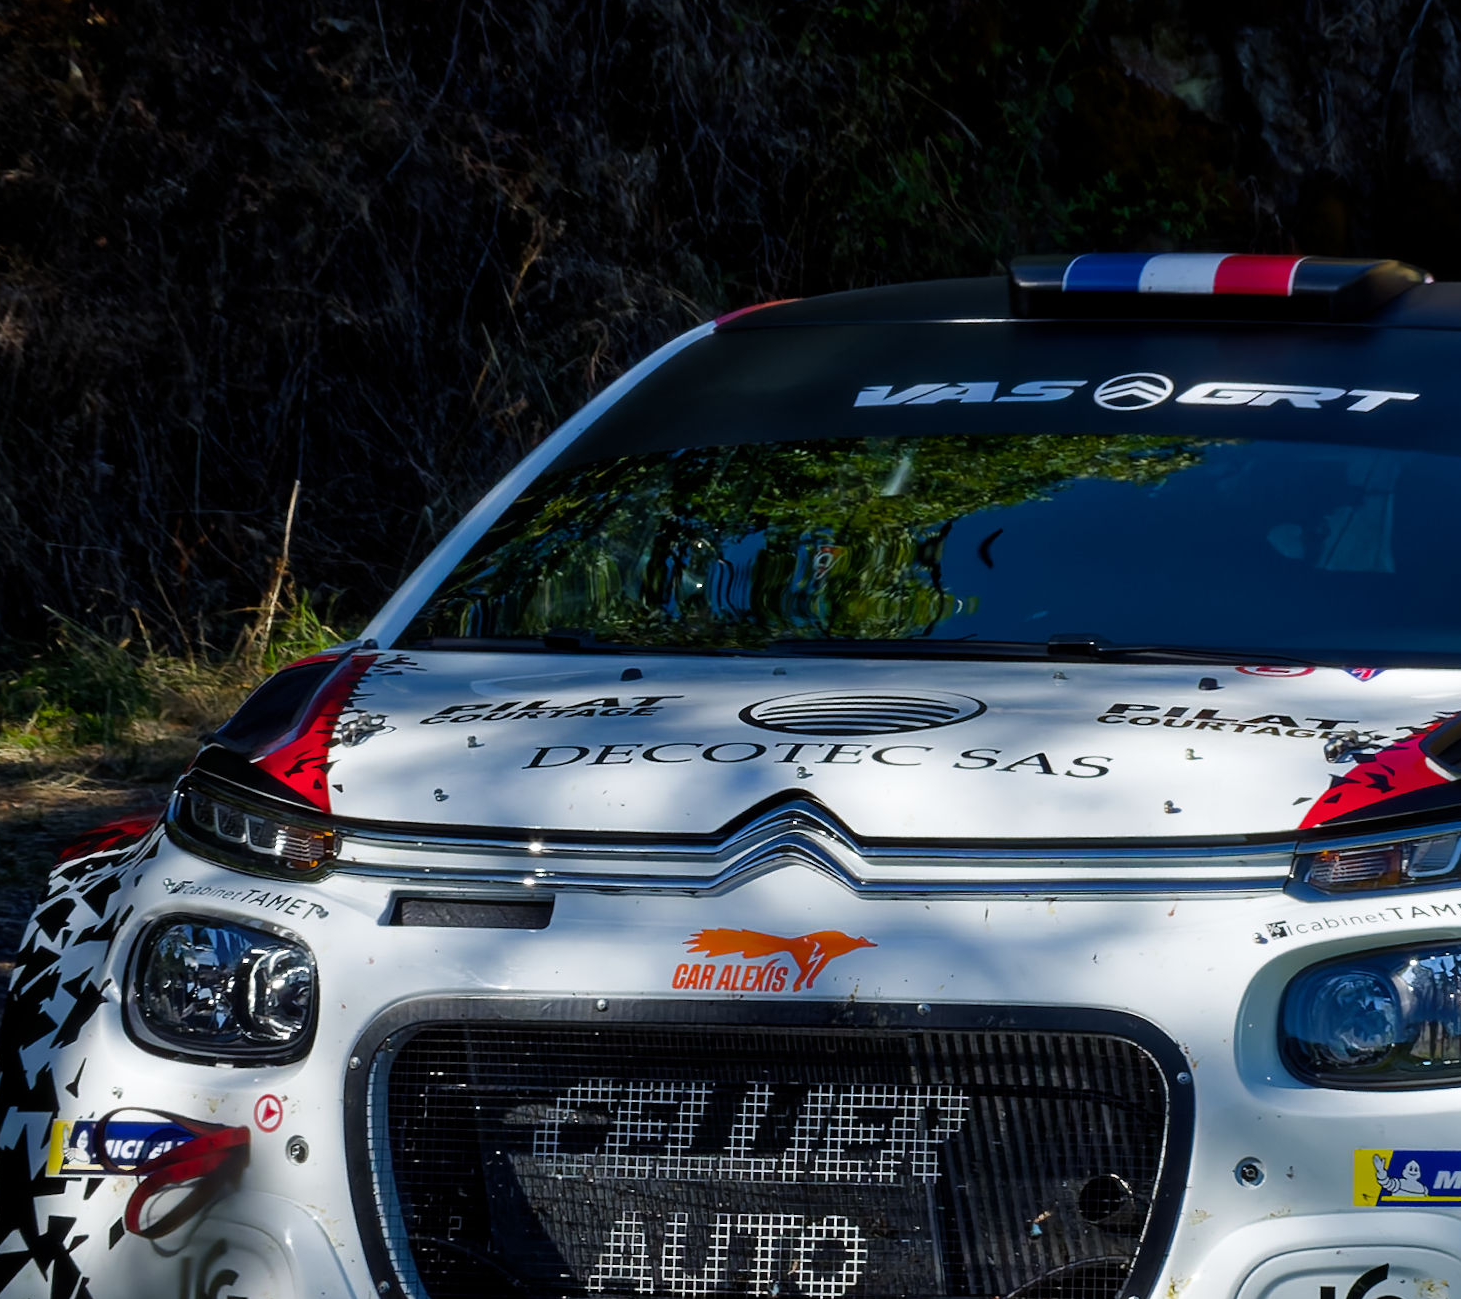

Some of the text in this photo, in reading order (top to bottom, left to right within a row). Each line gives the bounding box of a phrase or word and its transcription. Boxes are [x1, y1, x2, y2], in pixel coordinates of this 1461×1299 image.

[853, 380, 1420, 413] VAS GRT
[419, 706, 664, 725] COURTAGE
[434, 695, 685, 716] PILAT
[1105, 703, 1360, 730] PILAT
[521, 741, 1114, 779] DECOTEC SAS
[672, 958, 788, 992] CAR ALEXIS
[585, 1210, 868, 1299] AUTO
